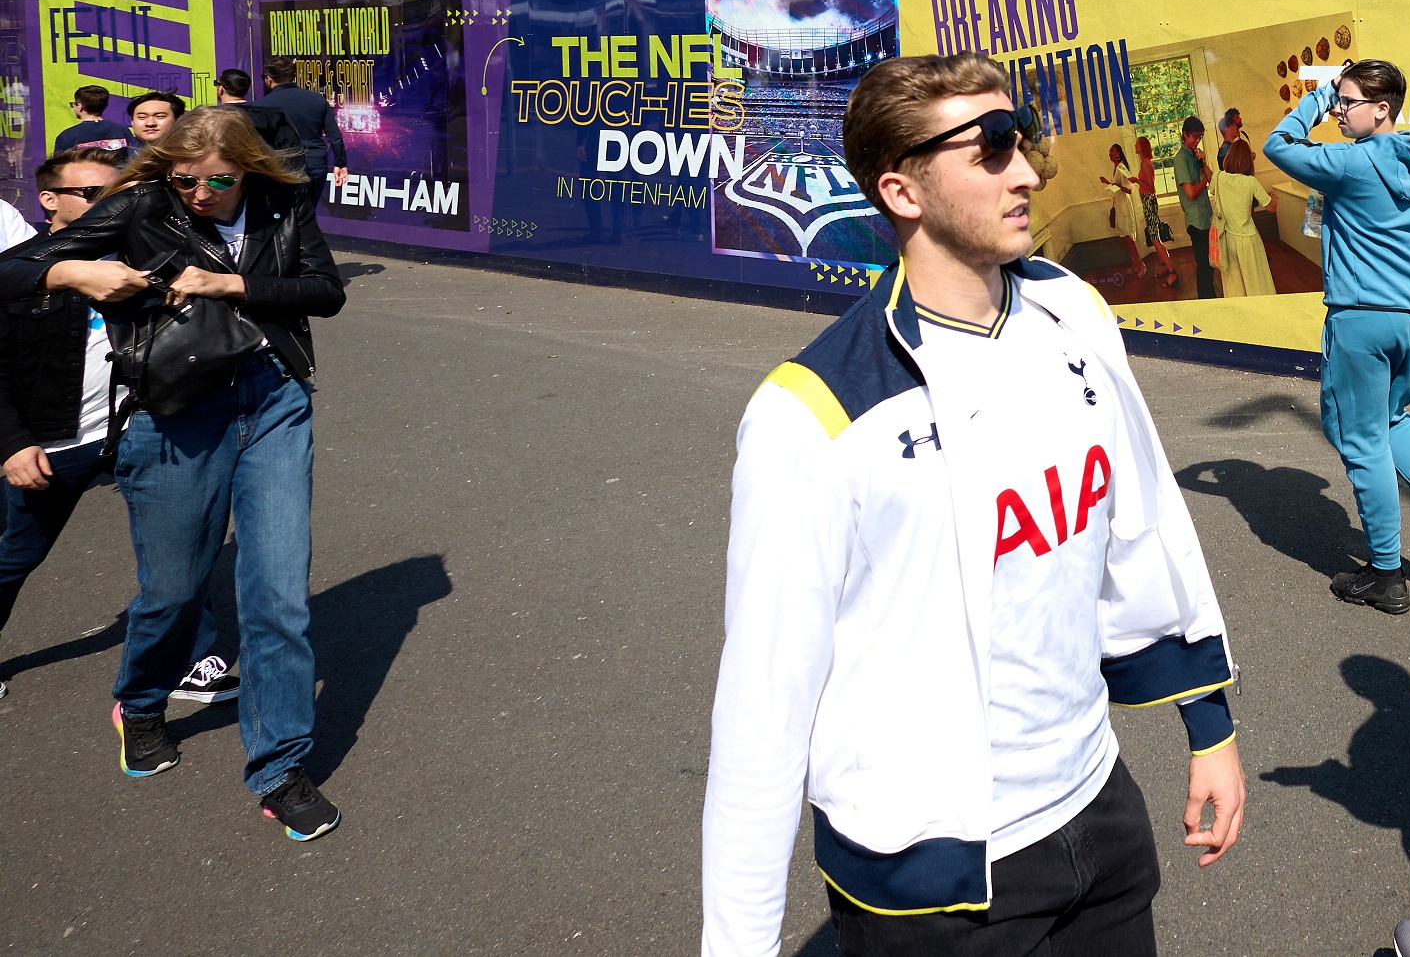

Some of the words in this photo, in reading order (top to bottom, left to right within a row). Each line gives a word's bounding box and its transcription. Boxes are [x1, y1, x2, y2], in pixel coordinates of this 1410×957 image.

[49, 6, 125, 64] FEEL
[269, 10, 322, 56] BRINGING
[323, 7, 346, 56] THE
[347, 6, 391, 56] WORLD
[551, 35, 640, 79] THE
[649, 33, 743, 79] NFL
[336, 59, 375, 109] SPORT
[511, 79, 746, 131] TOUCHES
[596, 129, 747, 181] DOWN
[326, 171, 460, 216] TENHAM
[556, 176, 574, 199] IN
[578, 177, 708, 210] TOTTENHAM
[748, 164, 859, 203] NFL
[993, 444, 1112, 573] AIA
